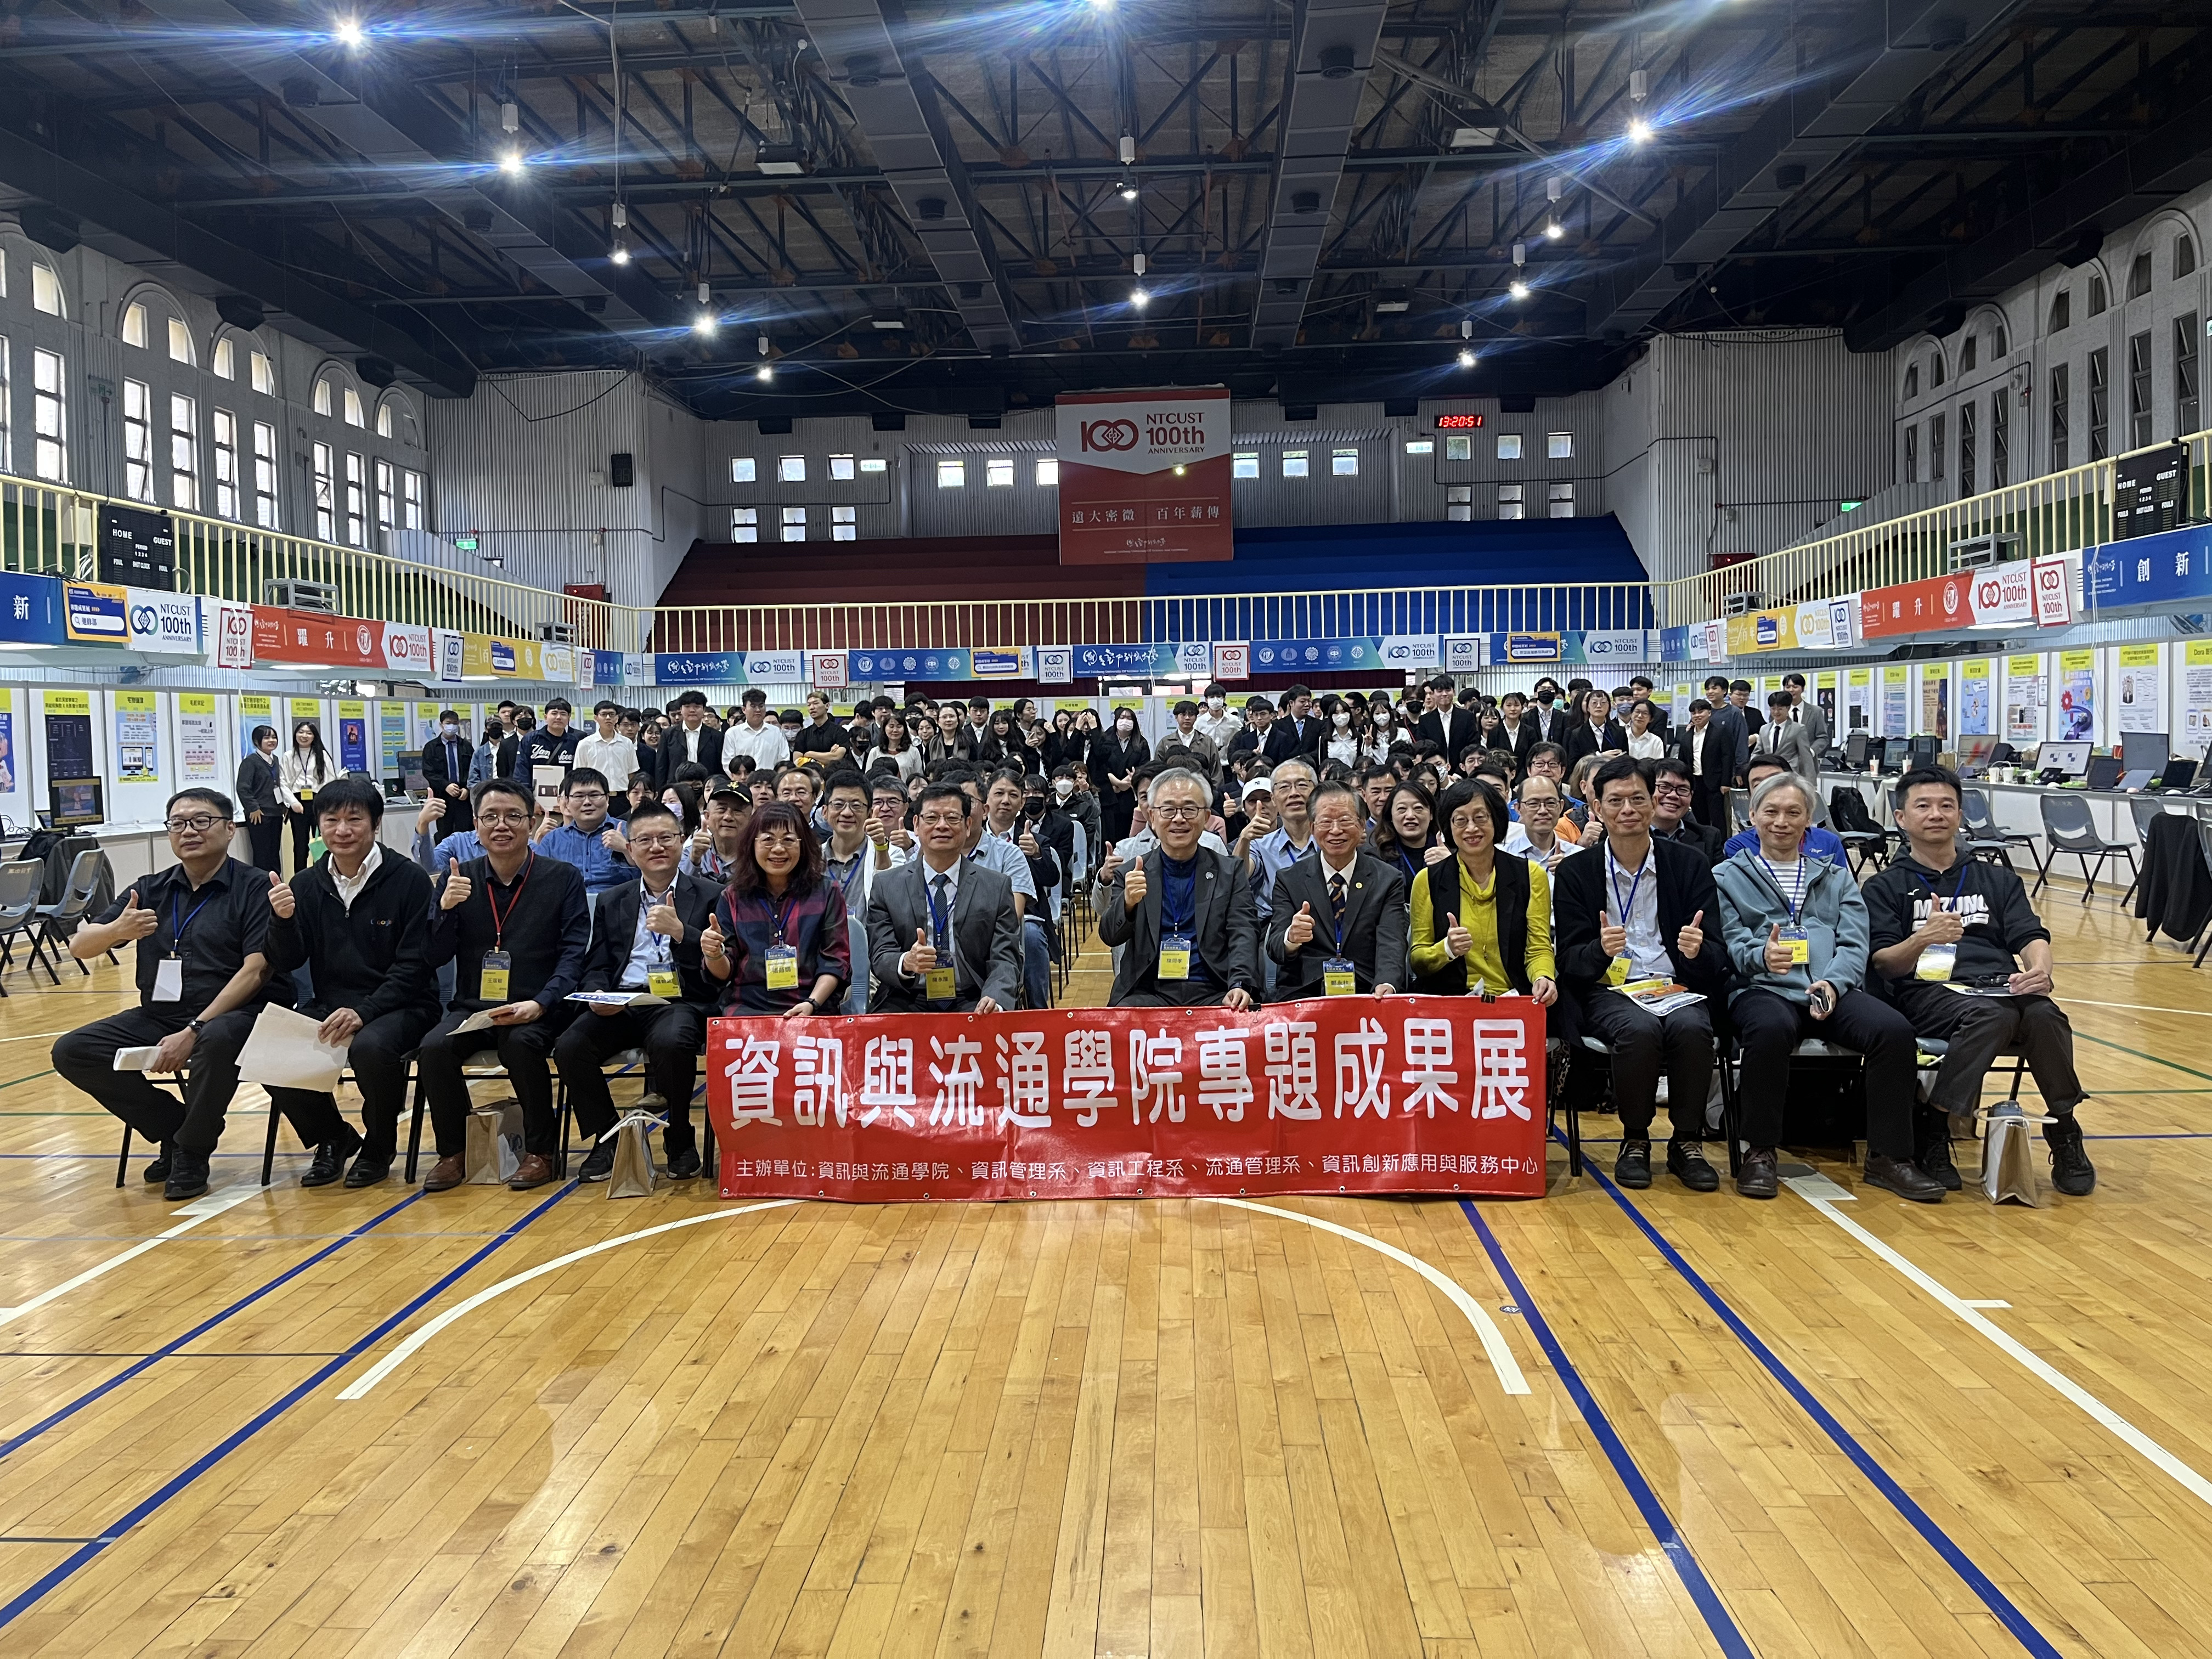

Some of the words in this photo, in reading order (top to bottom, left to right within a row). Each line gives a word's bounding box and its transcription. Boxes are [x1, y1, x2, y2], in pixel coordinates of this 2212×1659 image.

[1146, 413, 1205, 425] NTCUST
[1438, 416, 1482, 427] 13:20:51
[1146, 427, 1205, 445] 100th
[2156, 470, 2177, 481] GUEST
[2118, 479, 2136, 490] HOME
[112, 528, 132, 539] HOME
[153, 537, 172, 546] GUEST
[2137, 551, 2189, 583] 創新
[2002, 572, 2027, 585] NTCUST
[2002, 585, 2027, 602] 100th
[2042, 592, 2061, 601] NTCUST
[13, 595, 30, 620] 新
[160, 603, 191, 616] NTCUST
[2043, 602, 2063, 614] 100th
[160, 616, 191, 635] 100th
[409, 634, 426, 643] NTCUST
[225, 646, 245, 657] 100h
[409, 643, 427, 657] 100th
[1412, 648, 1435, 657] 100th
[447, 664, 458, 673] 100th
[724, 1017, 1532, 1130] 資訊與流通學院專題成果展
